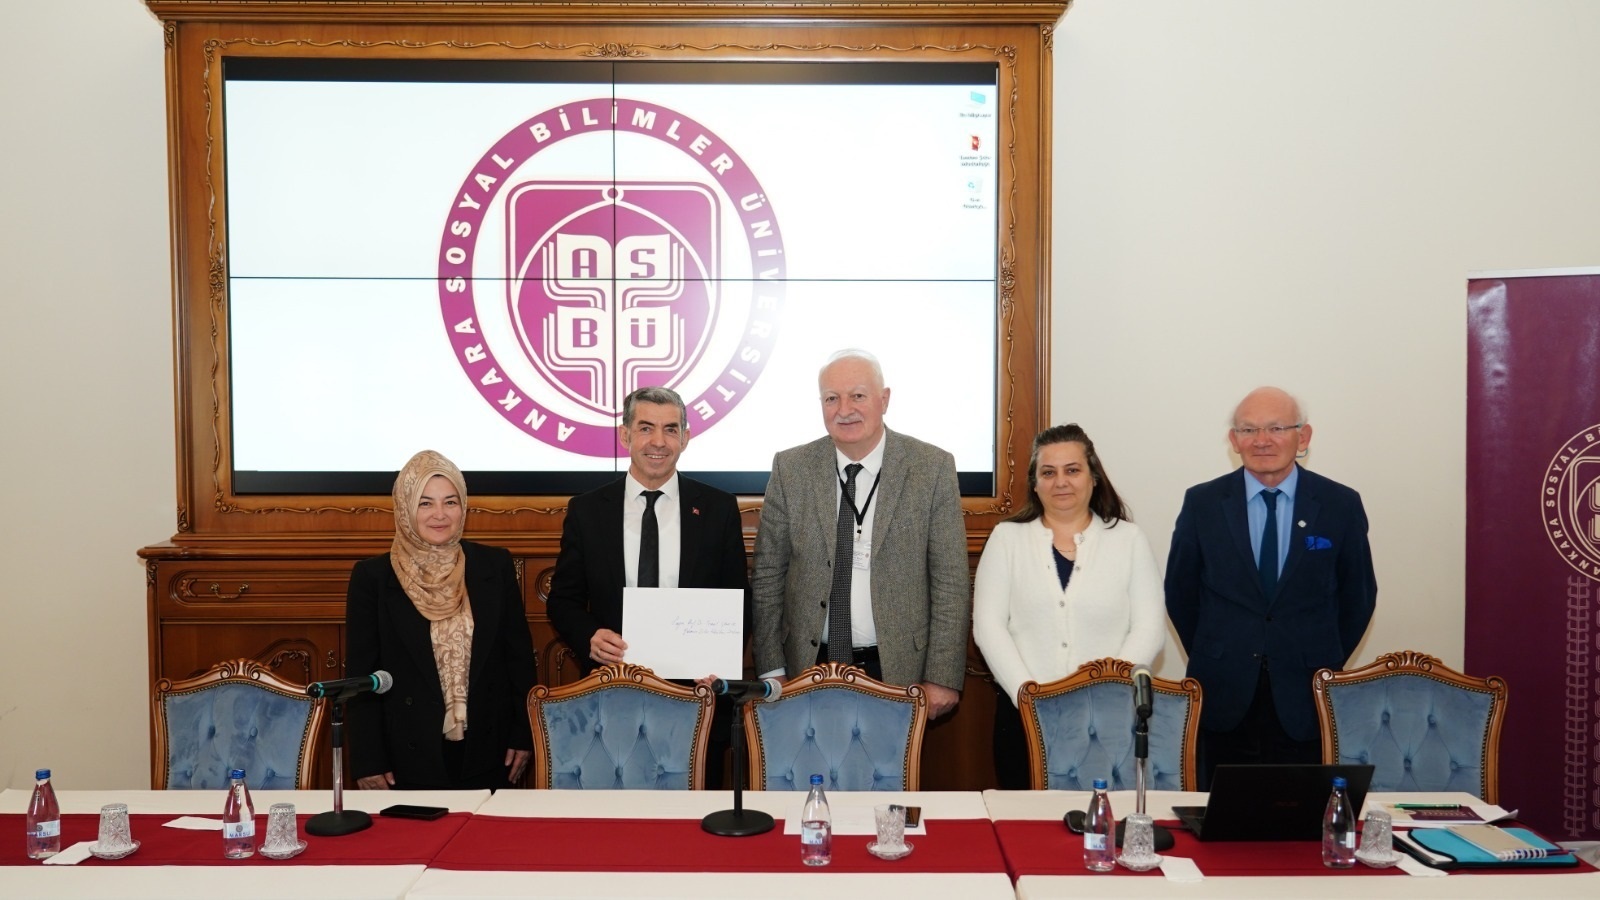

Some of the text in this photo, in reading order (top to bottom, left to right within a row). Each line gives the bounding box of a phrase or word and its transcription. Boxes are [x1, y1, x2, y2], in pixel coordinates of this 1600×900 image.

[445, 101, 783, 442] ANKARA SOSYAL BİLİMLER ÜNİVERSİTE
[1546, 446, 1578, 507] SOSYAL
